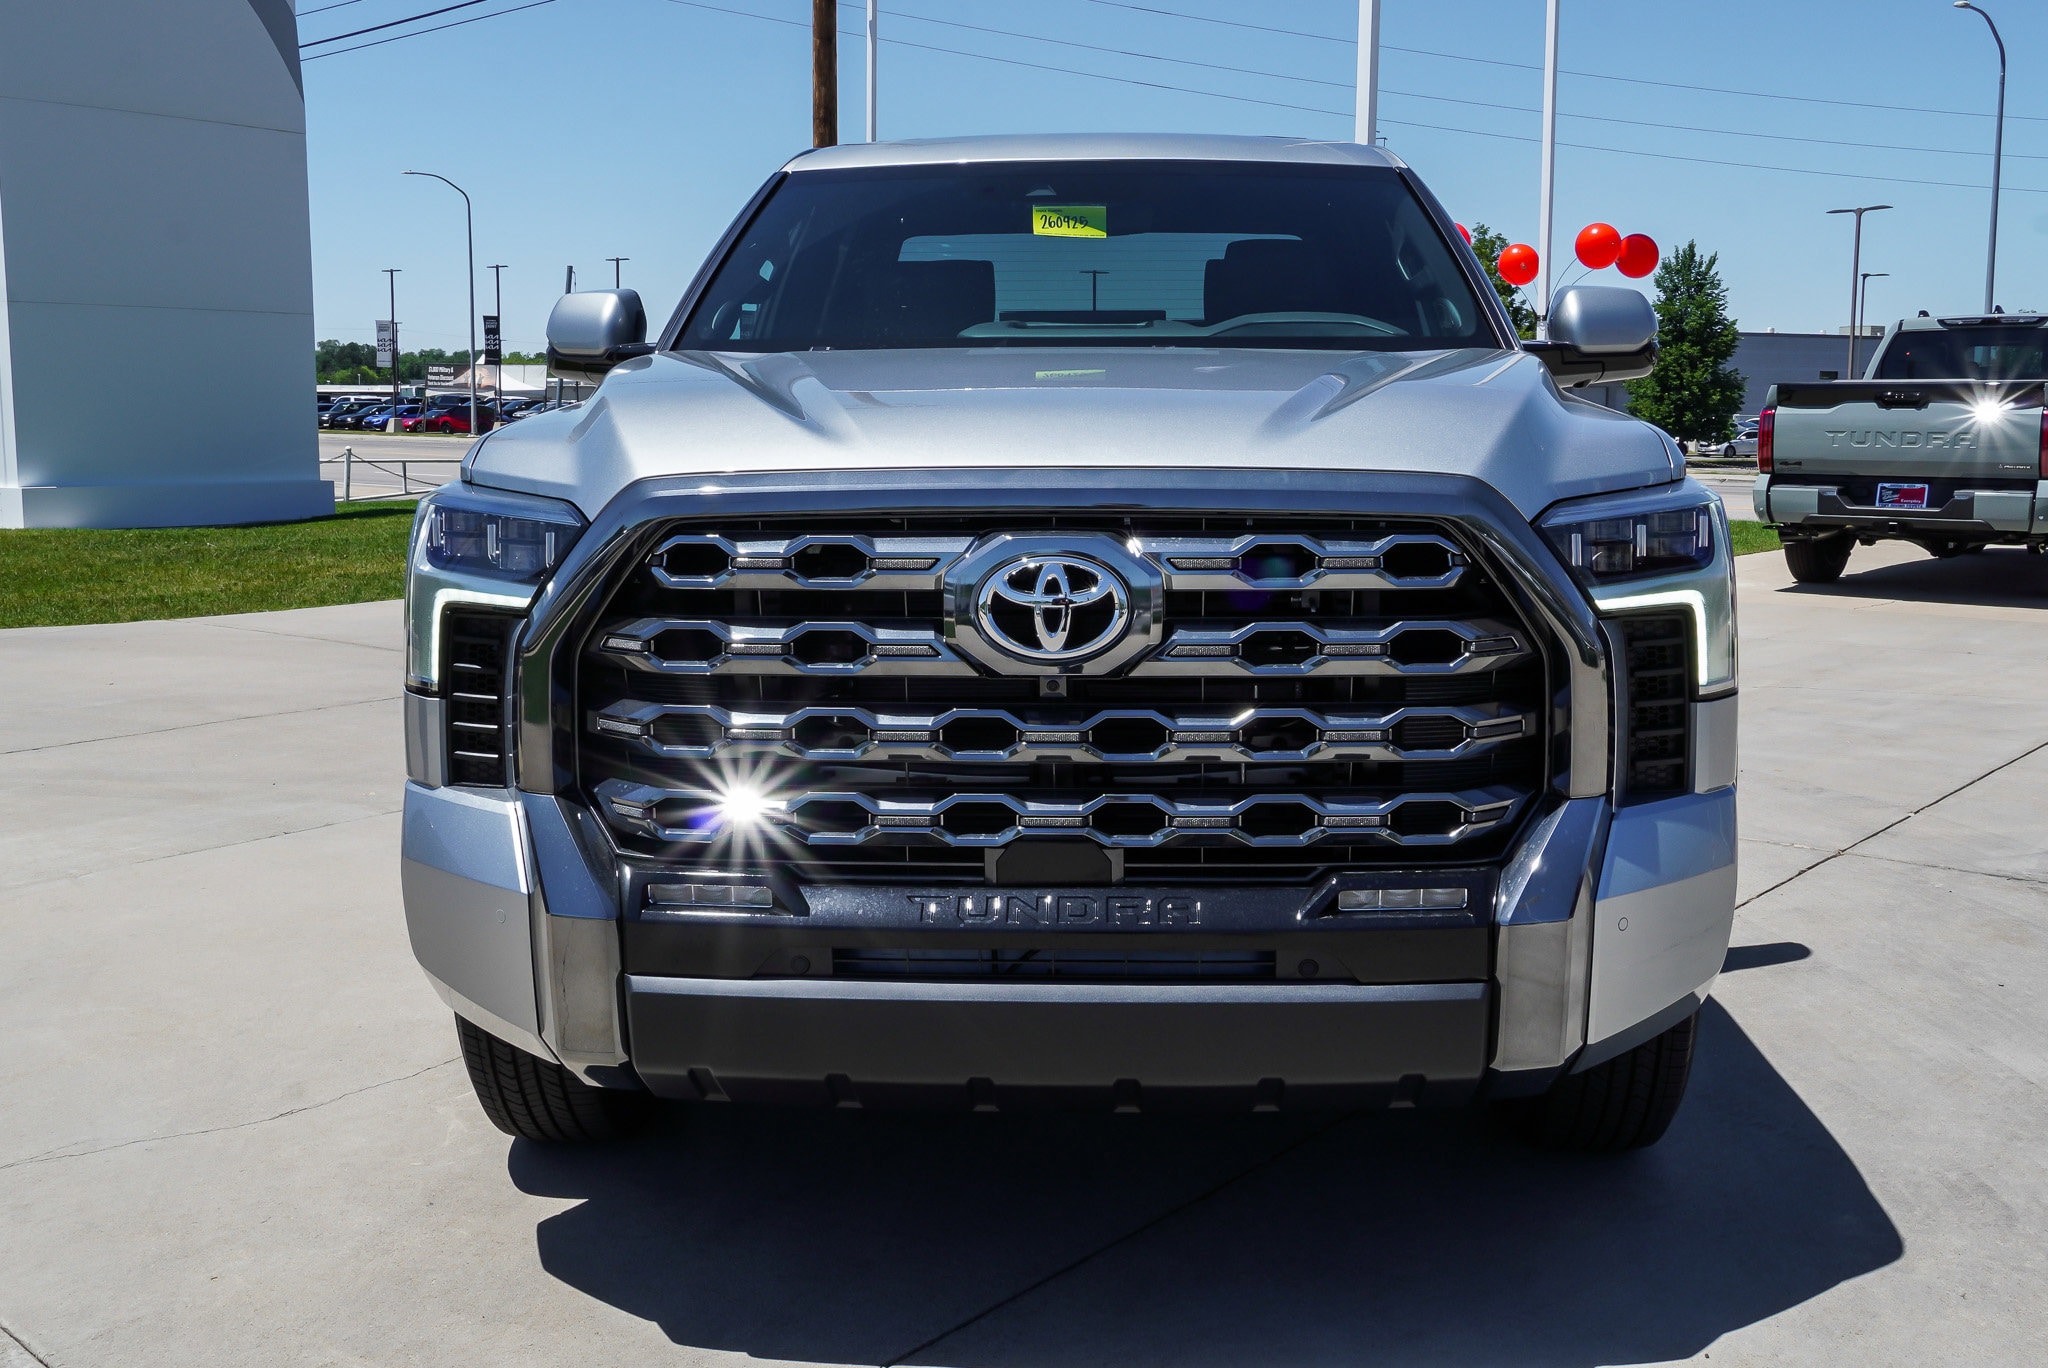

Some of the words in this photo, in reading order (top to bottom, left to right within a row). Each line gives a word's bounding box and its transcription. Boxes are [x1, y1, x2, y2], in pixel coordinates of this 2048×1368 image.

[1040, 214, 1089, 229] 260925
[1825, 430, 1979, 449] TUNDRA
[906, 895, 1201, 925] TUNDRA
